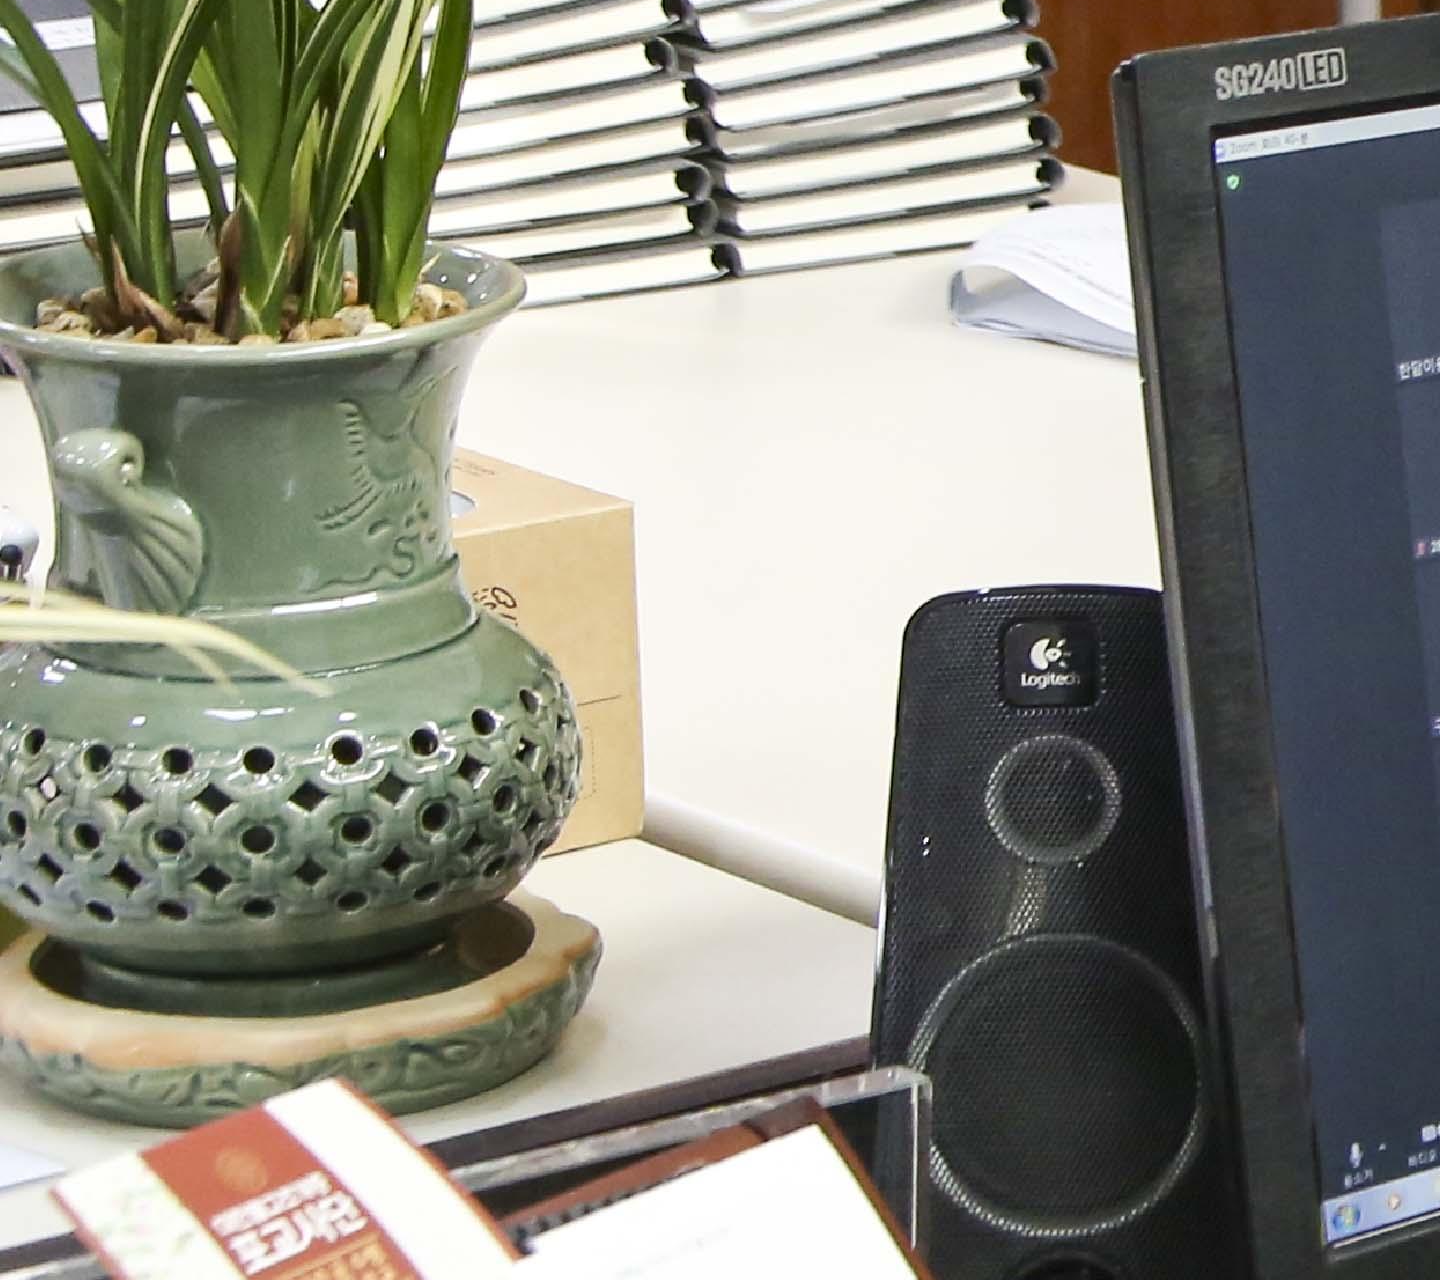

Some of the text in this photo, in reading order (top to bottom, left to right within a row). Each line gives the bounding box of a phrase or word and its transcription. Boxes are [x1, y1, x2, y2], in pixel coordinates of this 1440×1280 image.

[1215, 52, 1343, 101] SG240 LED
[1020, 670, 1081, 689] Logitech
